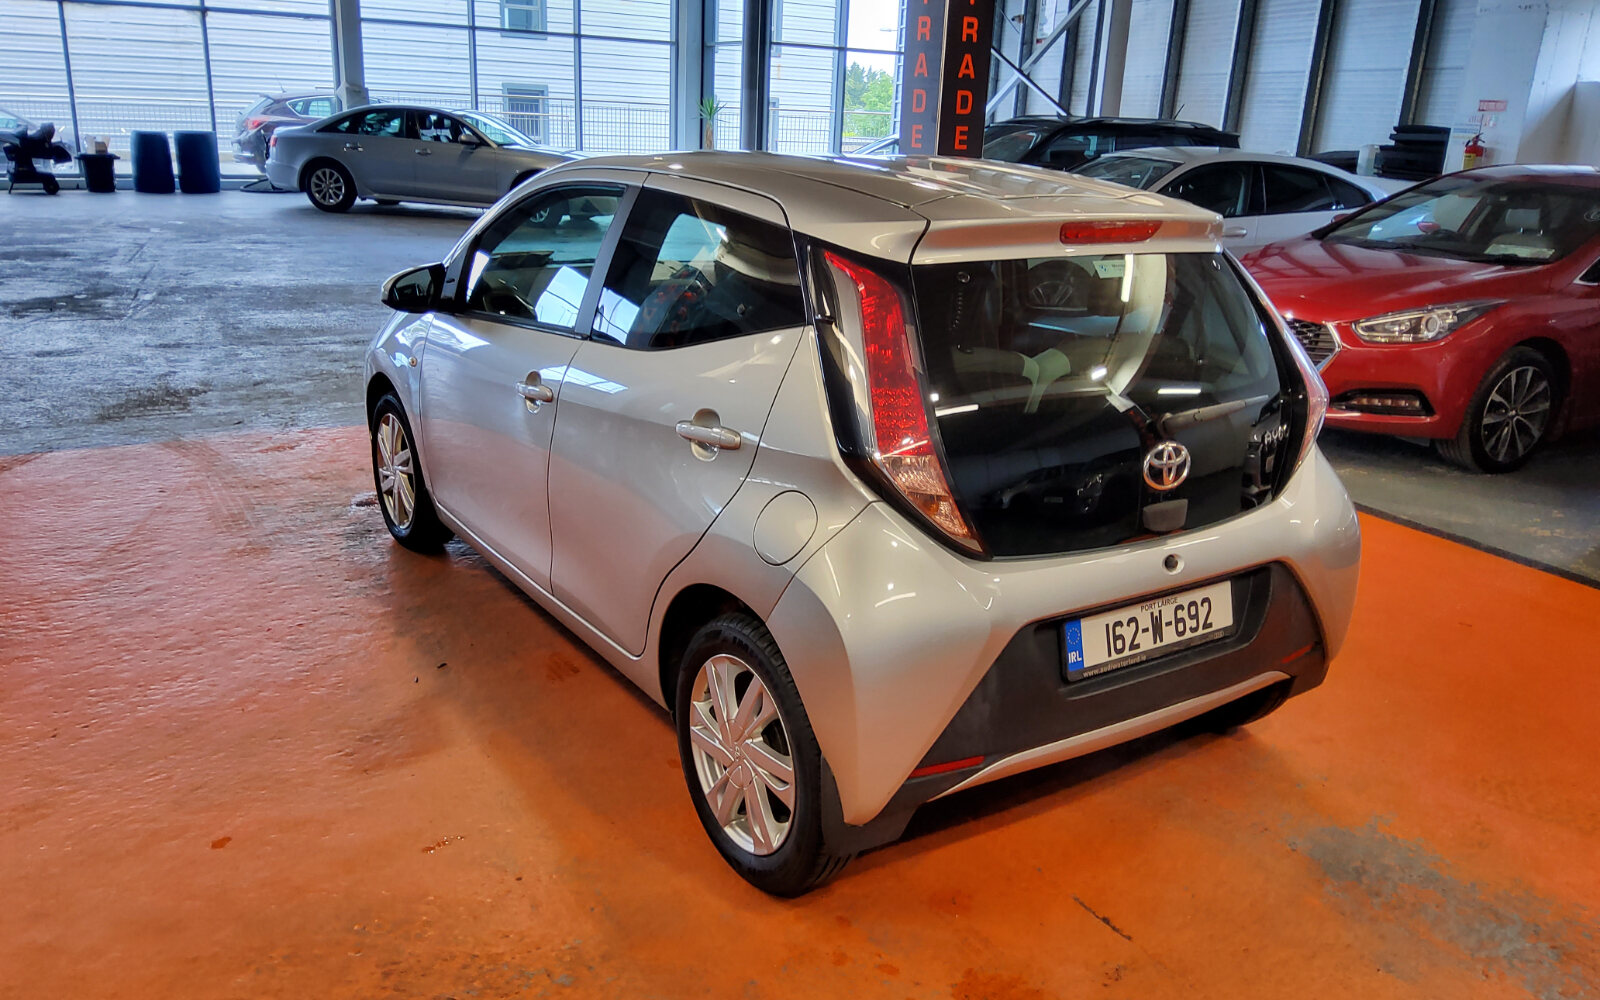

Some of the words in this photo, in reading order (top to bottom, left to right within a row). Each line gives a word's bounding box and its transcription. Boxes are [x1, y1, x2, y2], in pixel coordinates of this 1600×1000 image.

[911, 0, 931, 148] RADE
[954, 0, 979, 150] RADE
[1105, 597, 1213, 657] 162-W-692
[1140, 602, 1156, 612] PORT
[1068, 650, 1082, 664] IRL
